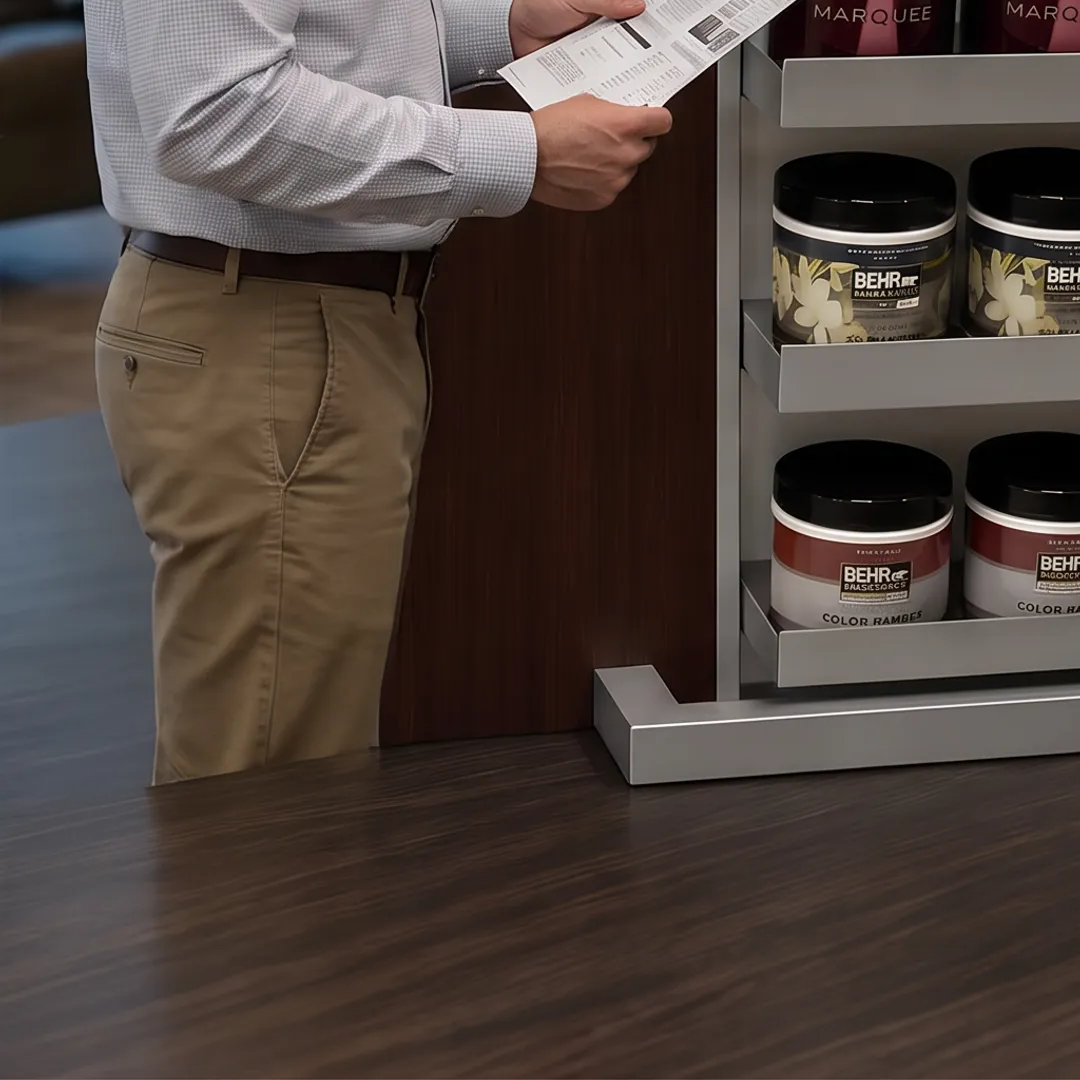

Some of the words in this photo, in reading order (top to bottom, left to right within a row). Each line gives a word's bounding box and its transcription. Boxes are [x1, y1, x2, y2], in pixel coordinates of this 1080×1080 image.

[814, 4, 932, 26] MARQUEE
[854, 271, 901, 289] BEHR
[844, 566, 891, 583] BEHR
[1017, 601, 1063, 614] COLOR
[822, 612, 868, 626] COLOR
